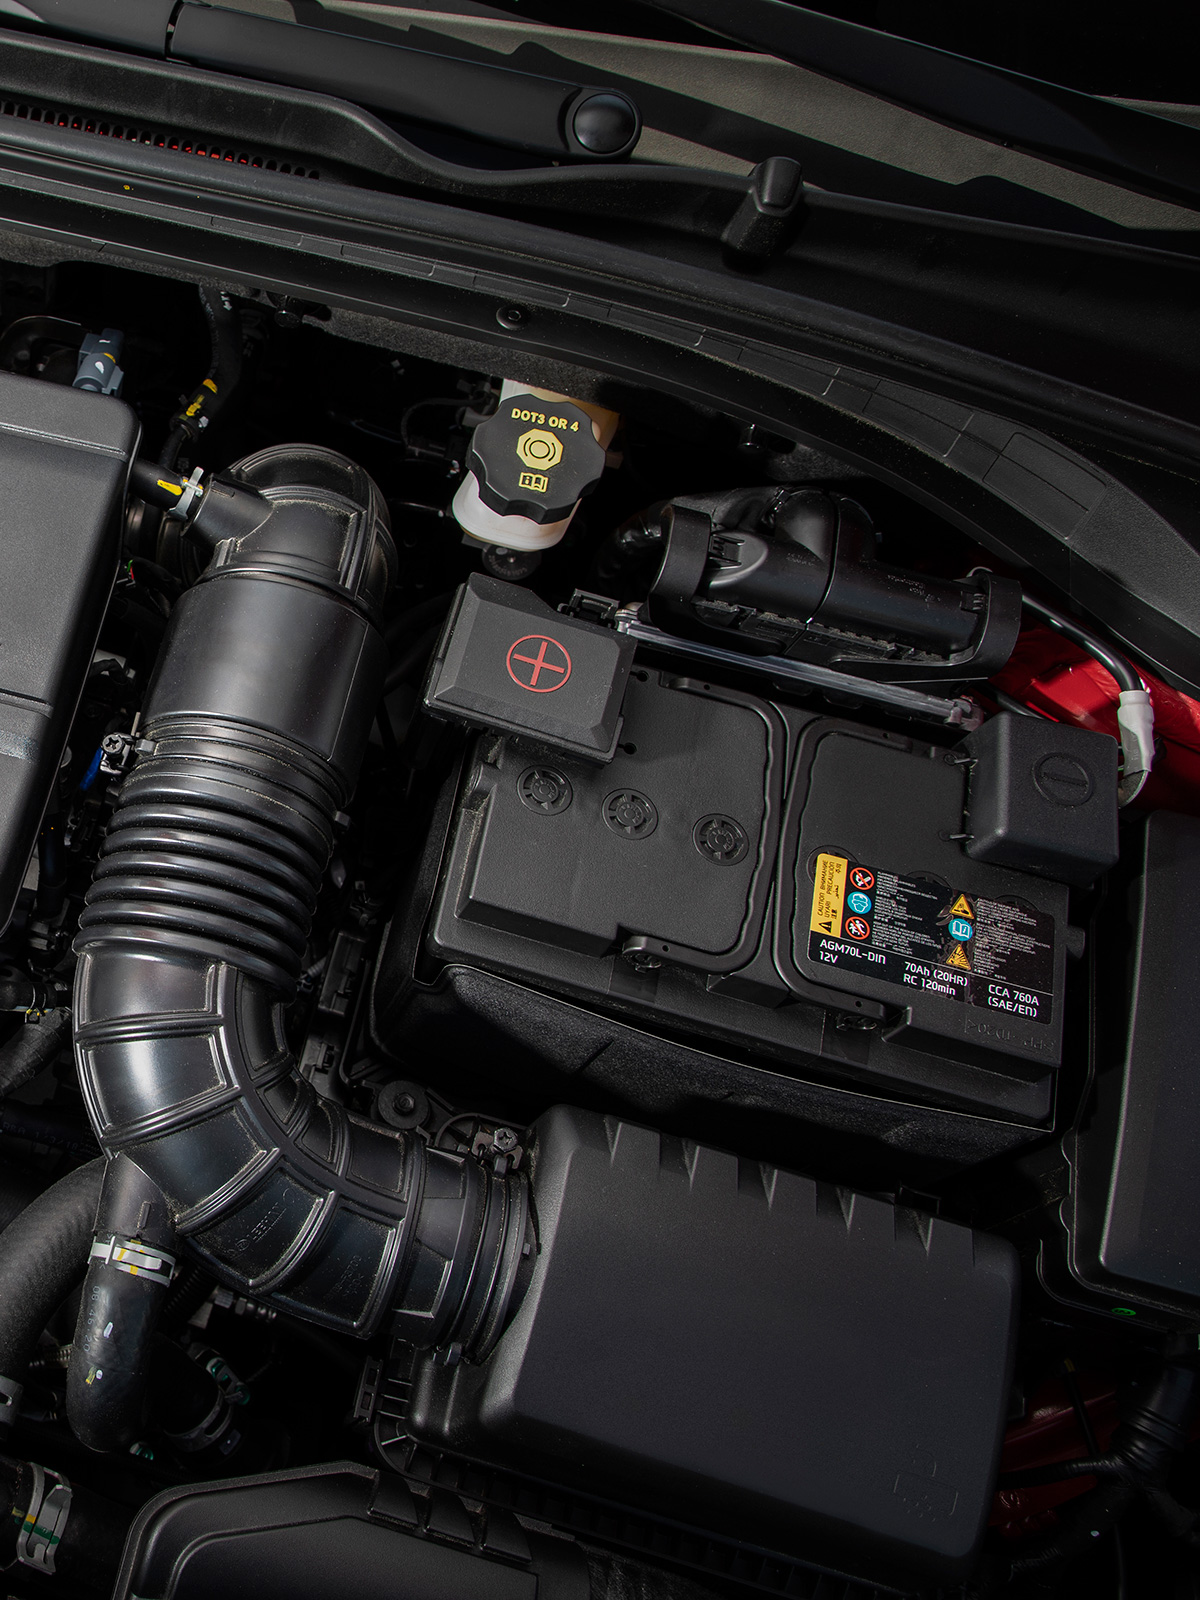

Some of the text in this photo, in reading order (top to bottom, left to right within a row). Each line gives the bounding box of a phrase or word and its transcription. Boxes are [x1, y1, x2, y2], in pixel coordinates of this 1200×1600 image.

[511, 408, 579, 432] DOT3 OR 4
[817, 892, 825, 917] CAUTION
[820, 951, 838, 963] 12V
[903, 973, 956, 995] RC 120min
[904, 961, 968, 986] 70Ah (20HR)
[988, 984, 1040, 1006] CCA 760A
